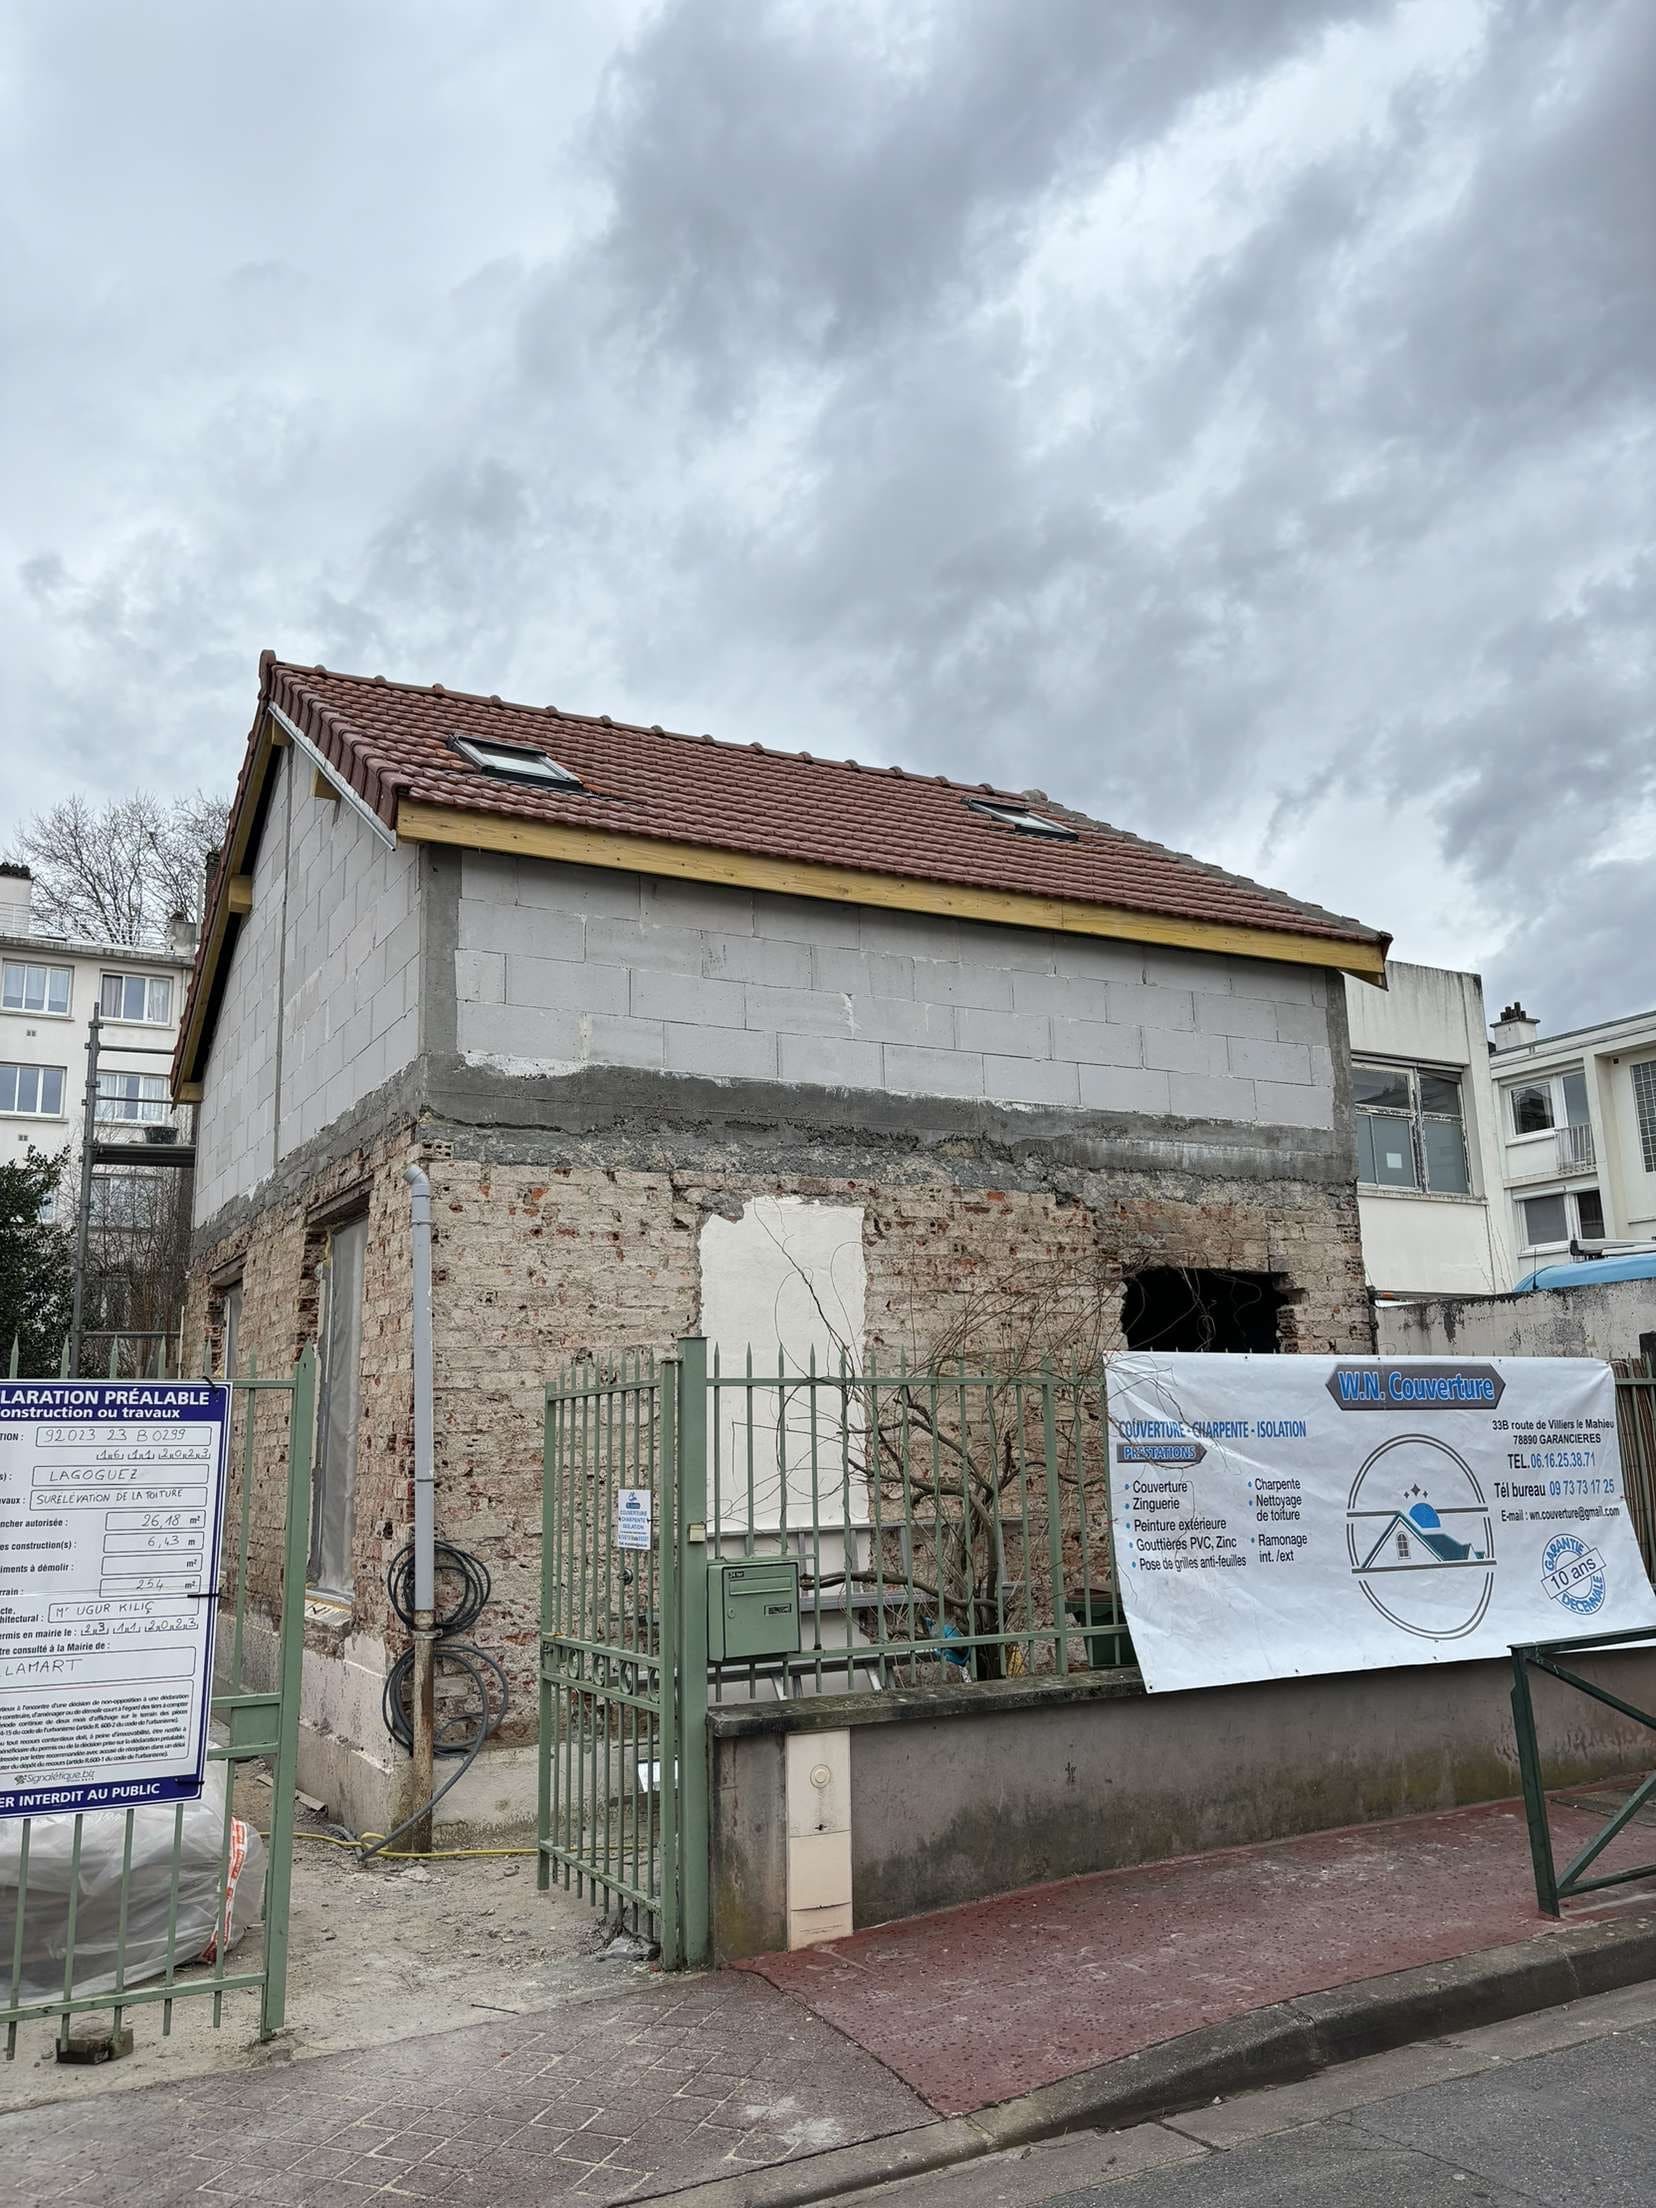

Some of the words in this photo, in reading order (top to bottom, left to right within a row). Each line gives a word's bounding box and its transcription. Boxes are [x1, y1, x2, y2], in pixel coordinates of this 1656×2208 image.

[1337, 1371, 1386, 1400] W.N.
[1388, 1371, 1495, 1400] Couverture
[0, 1390, 99, 1404] LARATION
[104, 1388, 209, 1405] PRÉALABLE
[0, 1406, 93, 1418] onstruction
[97, 1409, 117, 1418] ou
[122, 1407, 180, 1418] travaux
[1120, 1420, 1185, 1438] COUVERTURE
[1193, 1421, 1248, 1438] CHARPENTE
[1257, 1421, 1307, 1438] ISOLATION
[1511, 1420, 1534, 1430] route
[1536, 1420, 1546, 1429] de
[1548, 1419, 1575, 1429] Villiers
[1576, 1419, 1583, 1429] le
[1585, 1419, 1614, 1429] Mahieu
[107, 1429, 127, 1441] 23
[1513, 1435, 1537, 1445] 78890
[1540, 1433, 1601, 1444] GARANCIERES
[50, 1469, 137, 1481] LAGOGUEZ
[1132, 1480, 1187, 1493] Couverture
[1254, 1478, 1301, 1492] Charpente
[1494, 1482, 1509, 1498] Tél
[1512, 1483, 1546, 1497] bureau
[1549, 1481, 1561, 1495] 09
[1564, 1480, 1575, 1495] 73
[1577, 1480, 1588, 1495] 73
[1590, 1480, 1601, 1494] 17
[1604, 1479, 1615, 1493] 25
[116, 1491, 128, 1501] DE
[132, 1491, 142, 1500] LA
[1256, 1494, 1302, 1511] Nettoyage
[1133, 1497, 1180, 1513] Zinguerie
[1256, 1510, 1269, 1521] de
[1270, 1509, 1301, 1521] toiture
[1501, 1510, 1523, 1521] E-mail
[1529, 1506, 1620, 1521] wn.couverture@gmail.com
[25, 1518, 63, 1528] autorisée
[1134, 1519, 1176, 1532] Peinture
[1178, 1517, 1226, 1531] extérieure
[11, 1541, 72, 1551] construction(s)
[1136, 1537, 1187, 1551] Gouttières
[1190, 1537, 1214, 1551] PVC,
[1216, 1536, 1237, 1548] Zinc
[1258, 1533, 1307, 1548] Ramonage
[1259, 1550, 1274, 1562] int.
[1276, 1549, 1294, 1562] /ext
[1545, 1537, 1584, 1571] GARANTIE
[30, 1564, 35, 1573] à
[37, 1563, 69, 1572] démolir
[1140, 1558, 1160, 1571] Pose
[1162, 1558, 1173, 1570] de
[1175, 1557, 1199, 1572] grilles
[1200, 1555, 1247, 1569] anti-feuilles
[1551, 1570, 1569, 1590] 10
[1571, 1558, 1596, 1580] ans
[77, 1603, 111, 1615] UGUR
[35, 1629, 62, 1638] mairie
[64, 1629, 72, 1637] le
[12, 1645, 47, 1655] consulté
[49, 1644, 54, 1652] à
[57, 1644, 65, 1652] la
[67, 1642, 93, 1652] Mairie
[95, 1642, 105, 1650] de
[0, 1658, 83, 1676] LAMART
[19, 1791, 83, 1806] INTERDIT
[87, 1789, 108, 1801] AU
[111, 1783, 160, 1798] PUBLIC
